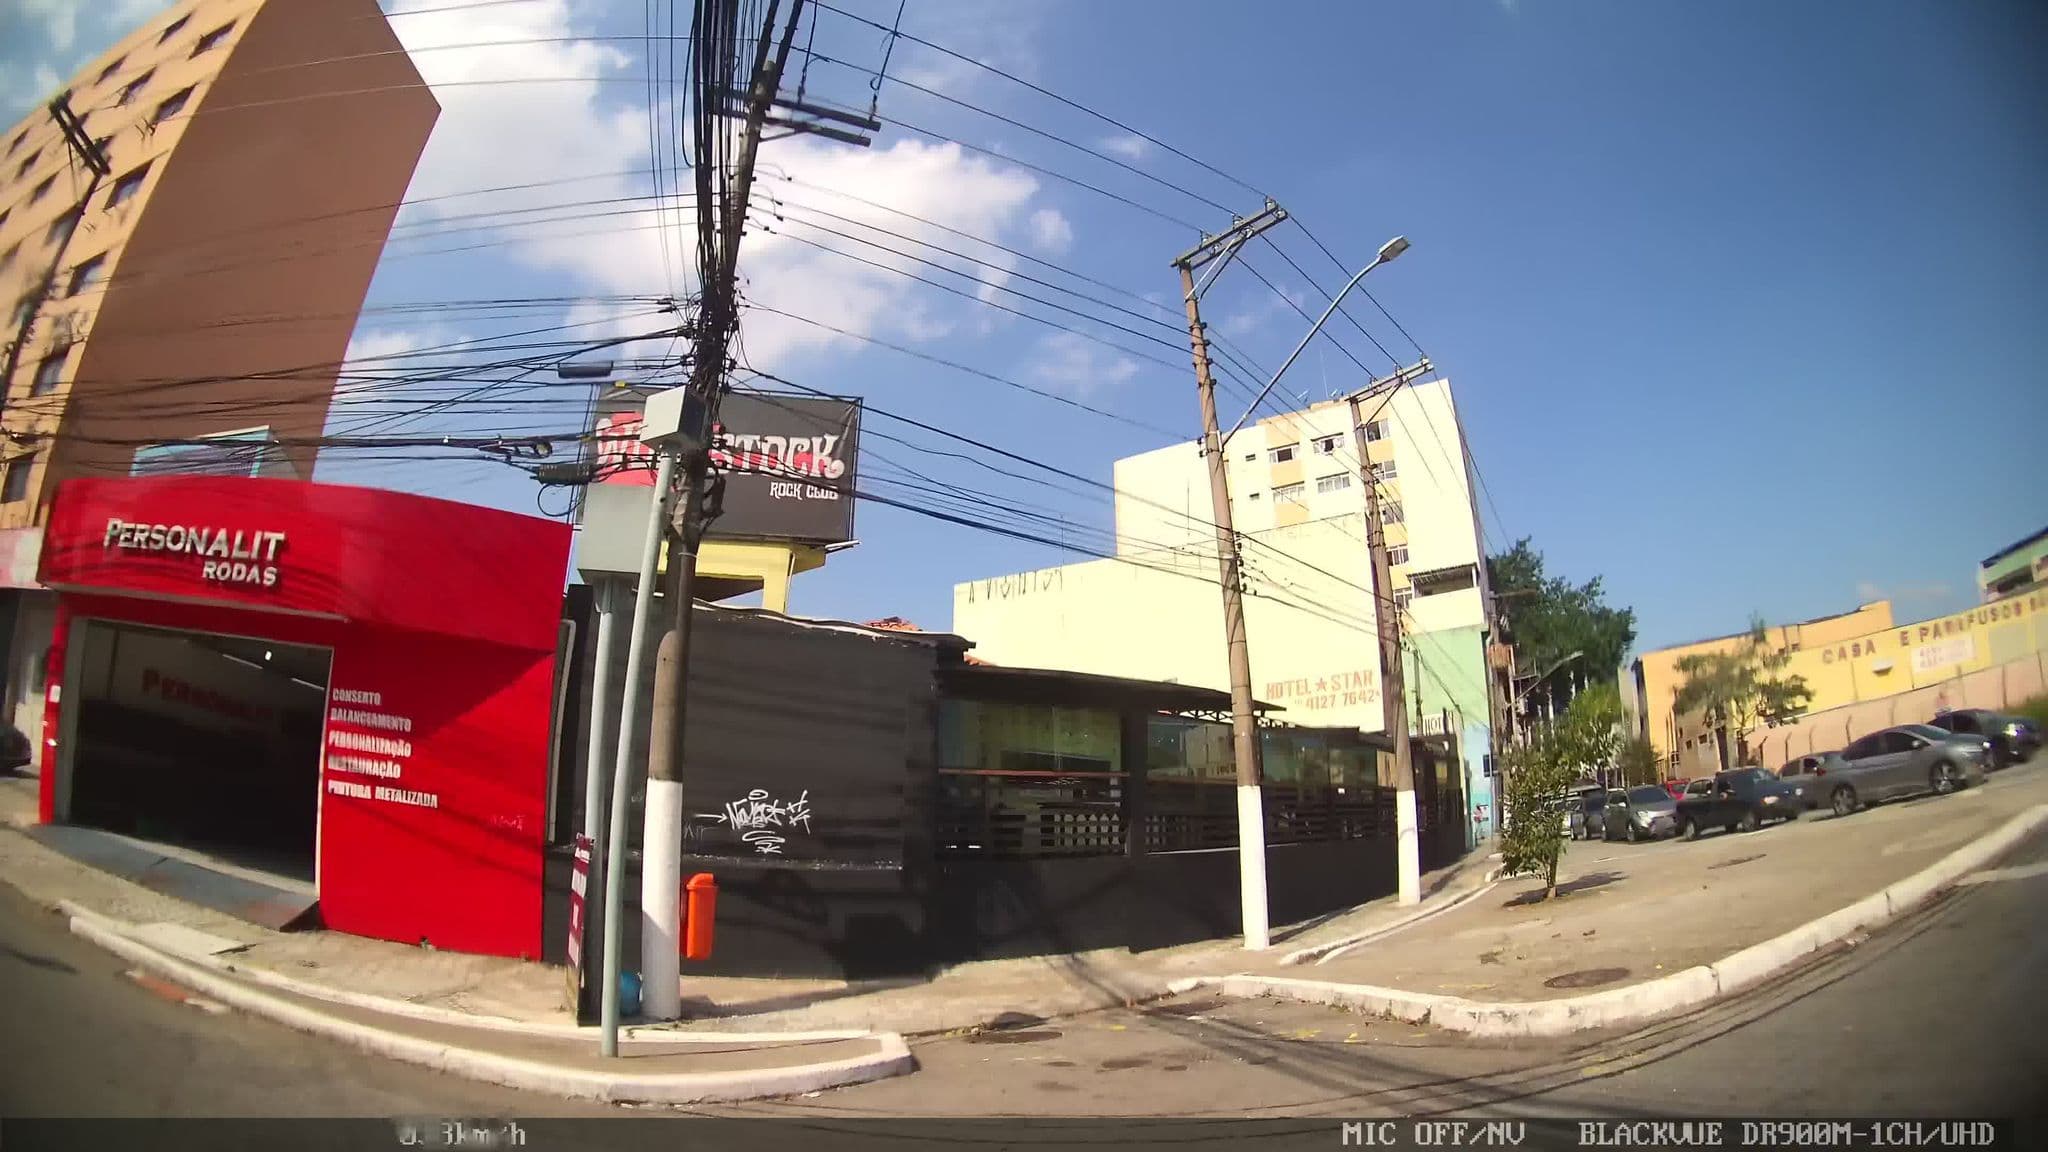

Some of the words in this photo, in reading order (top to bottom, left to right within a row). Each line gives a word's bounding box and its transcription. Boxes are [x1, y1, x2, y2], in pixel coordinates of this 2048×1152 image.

[770, 481, 802, 501] ROCK
[805, 484, 838, 501] CLUB
[103, 517, 285, 562] PERSONALIT
[202, 560, 278, 587] RODAS
[332, 688, 382, 706] CONSERTO
[1266, 678, 1311, 701] HOTEL
[1331, 669, 1373, 692] STAR
[1306, 694, 1336, 710] 4127
[330, 707, 412, 732] BALANCEAMENTO
[328, 730, 412, 758] PERSONALIZAÇÃO
[328, 779, 372, 799] PINTURA
[375, 785, 438, 808] METALIZADA
